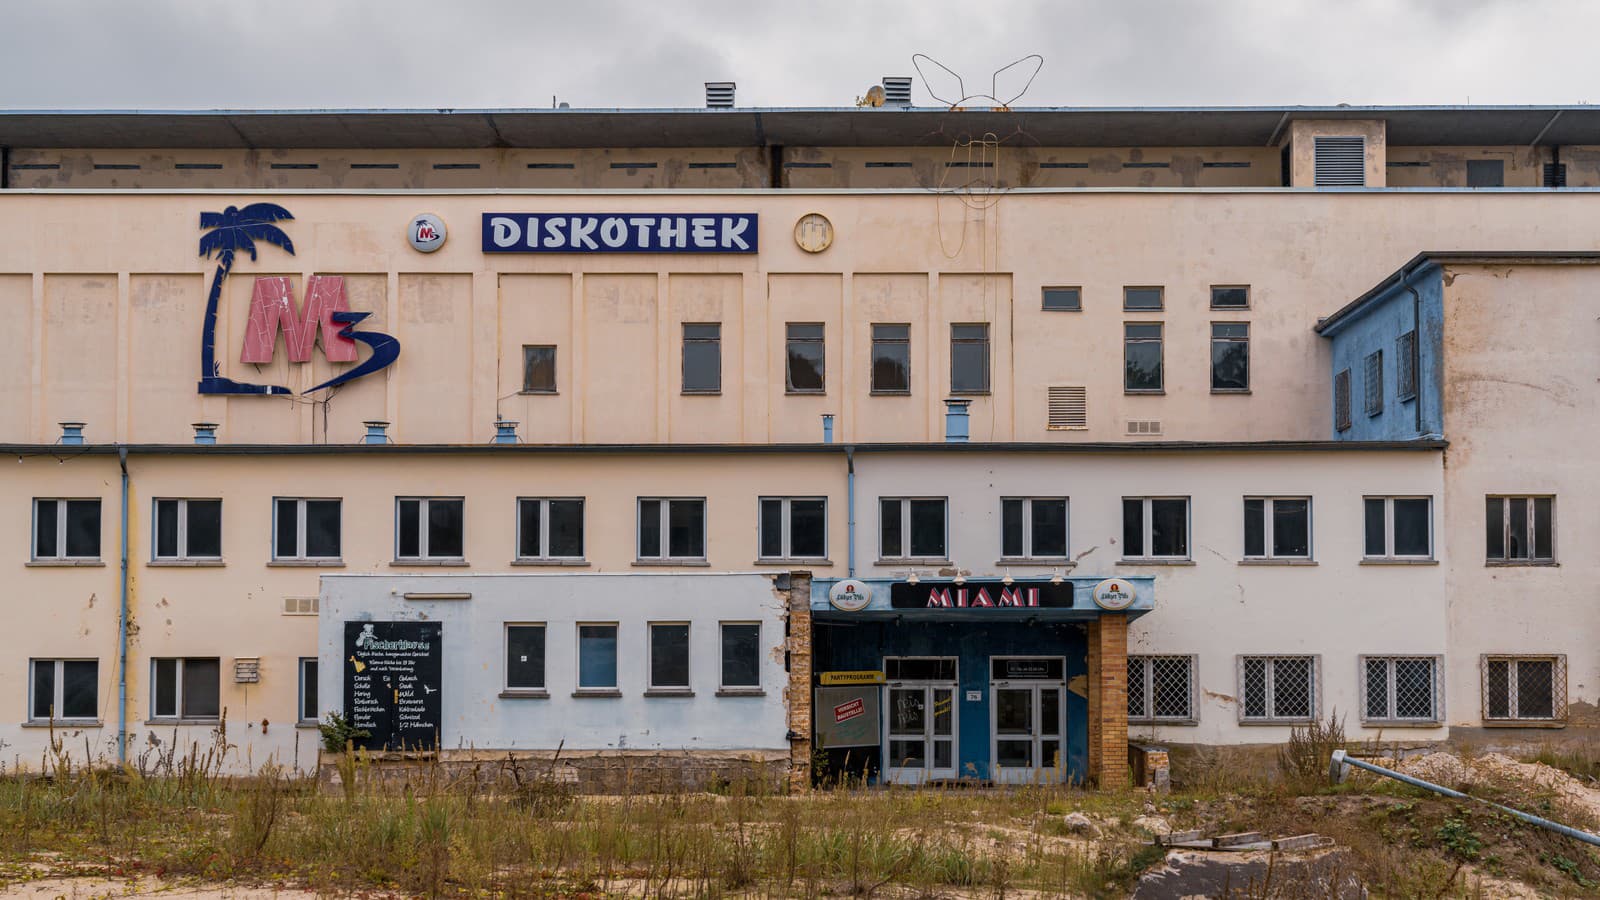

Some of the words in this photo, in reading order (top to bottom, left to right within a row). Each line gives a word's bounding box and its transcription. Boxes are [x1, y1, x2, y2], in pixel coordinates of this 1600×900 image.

[491, 216, 750, 250] DISKOTHEK
[926, 587, 1041, 608] MIAMI
[354, 690, 371, 699] Hering
